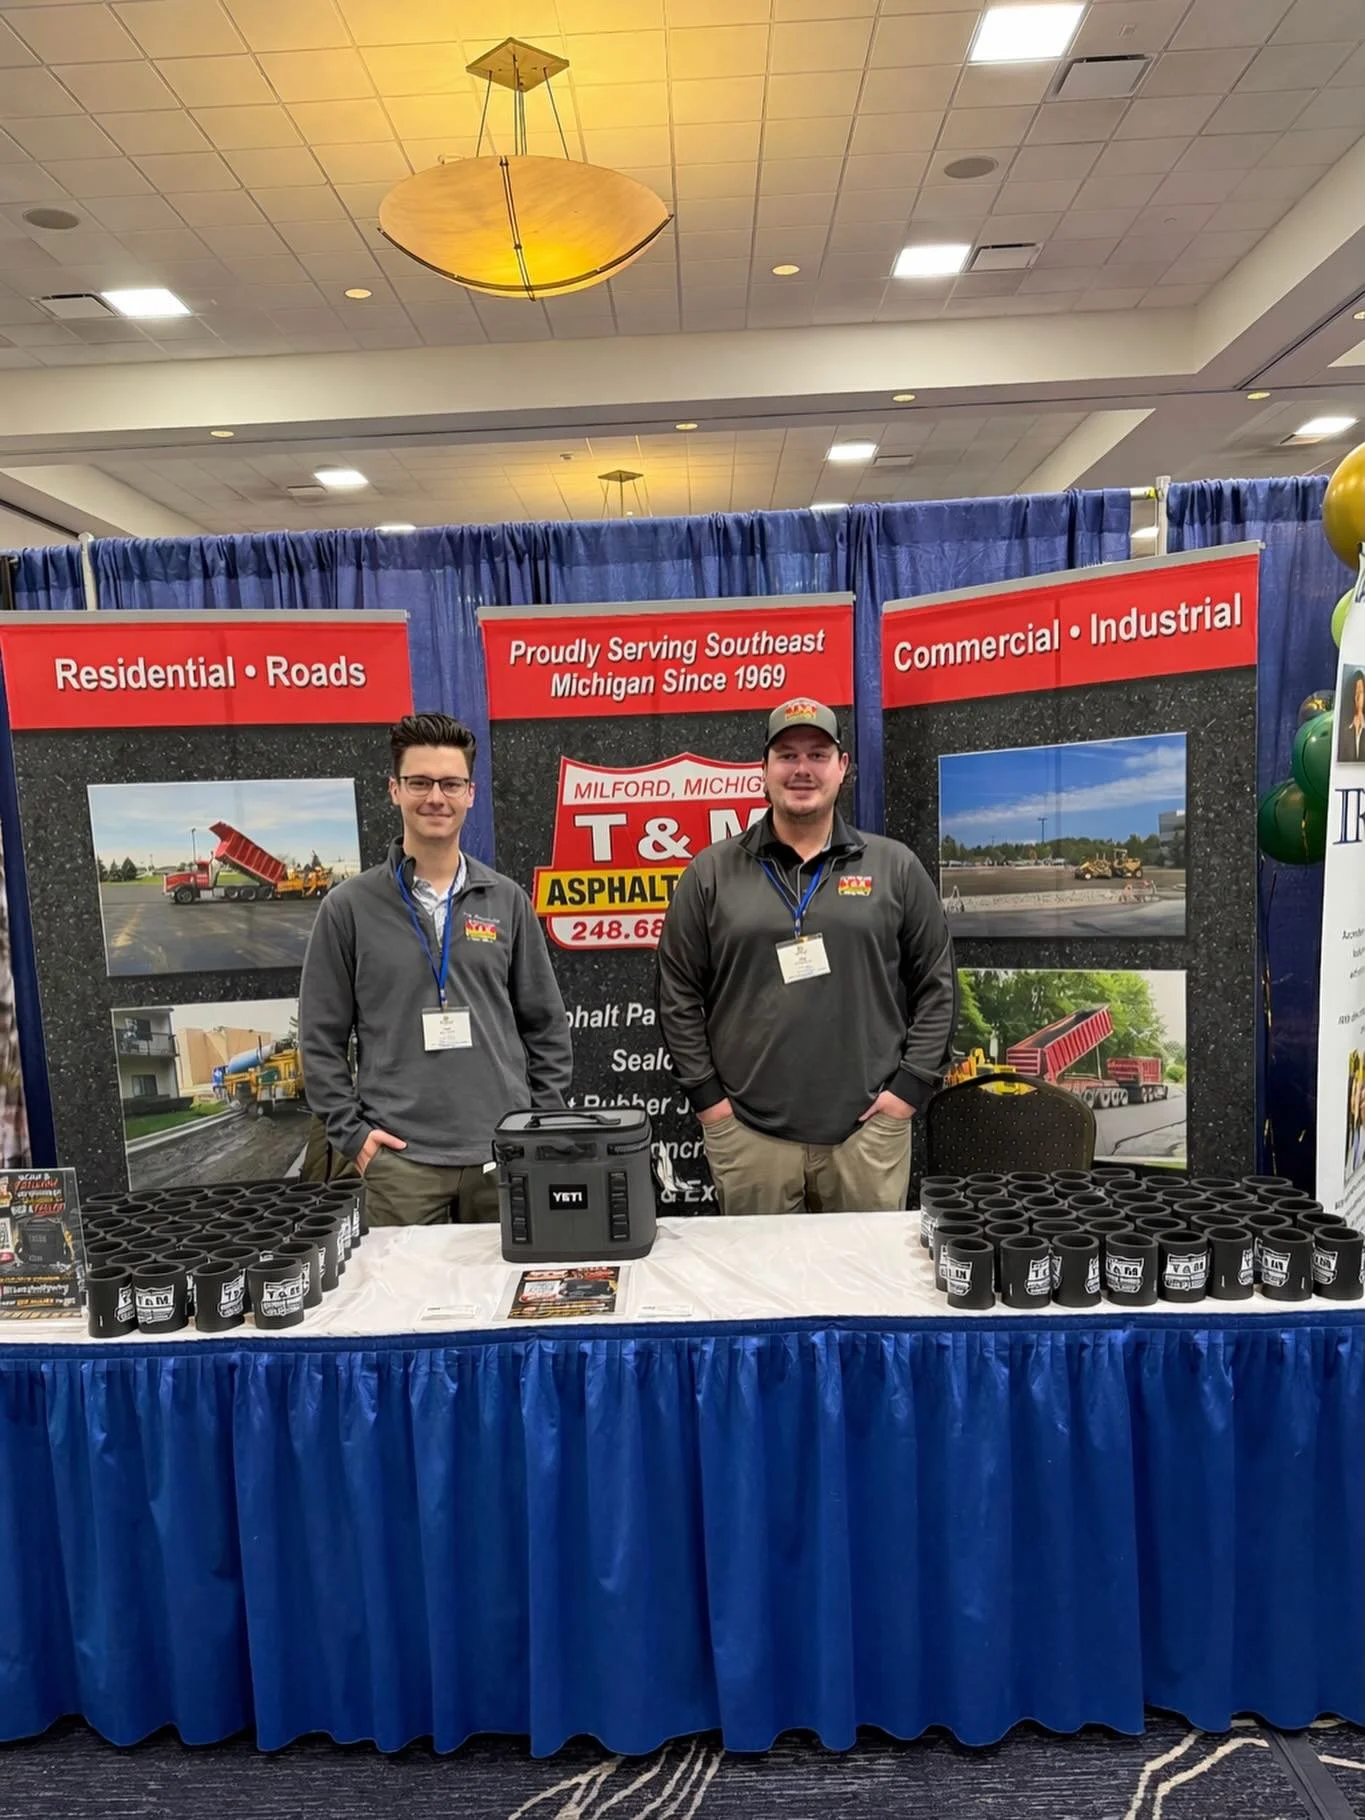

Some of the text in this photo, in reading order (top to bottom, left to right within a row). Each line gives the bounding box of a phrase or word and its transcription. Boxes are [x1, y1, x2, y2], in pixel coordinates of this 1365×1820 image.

[509, 629, 825, 669] Proudly Serving Southeast
[893, 592, 1241, 672] Commercial Industrial
[54, 655, 367, 690] Residential Roads
[550, 664, 785, 701] Michigan Since 1969
[574, 779, 676, 799] MILFORD,
[546, 874, 679, 906] ASPHALT
[552, 1191, 583, 1203] YETI
